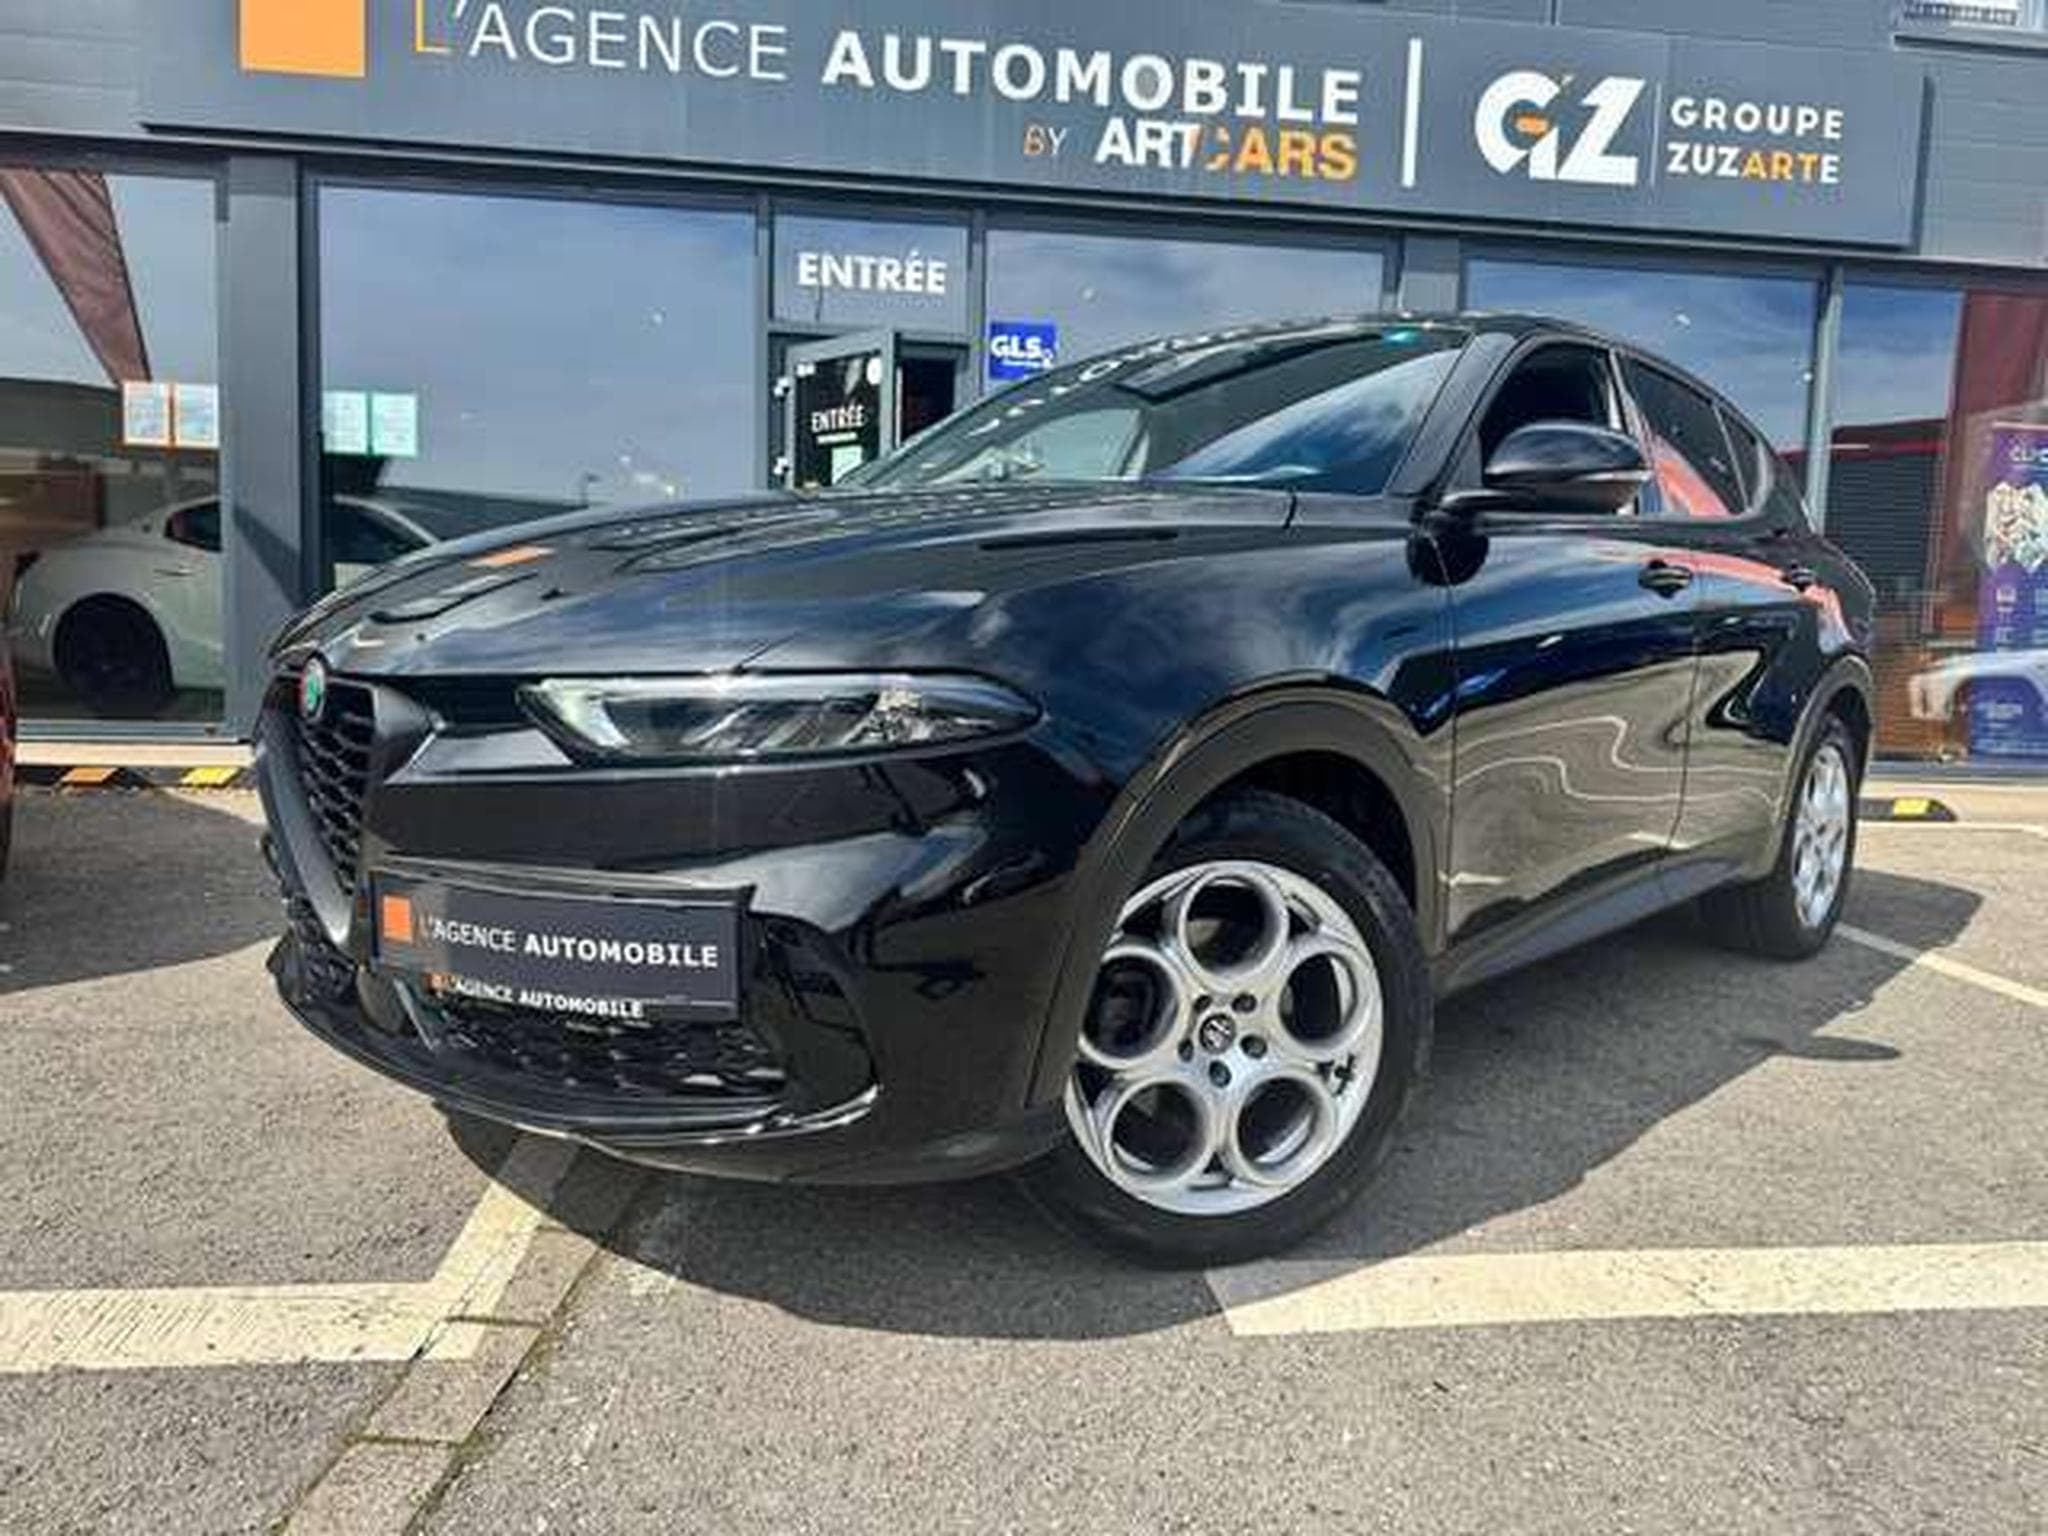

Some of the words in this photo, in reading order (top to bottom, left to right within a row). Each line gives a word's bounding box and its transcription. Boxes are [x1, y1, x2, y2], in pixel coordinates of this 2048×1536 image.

[820, 29, 1362, 124] AUTOMOBILE
[1669, 97, 1845, 141] GROUPE
[1022, 123, 1068, 157] BY
[1666, 141, 1842, 185] ZUZARTE
[797, 249, 947, 294] ENTRÉE
[811, 401, 865, 432] ENTRÉE
[524, 933, 718, 968] AUTOMOBILE
[519, 989, 643, 1018] AUTOMOBILE
